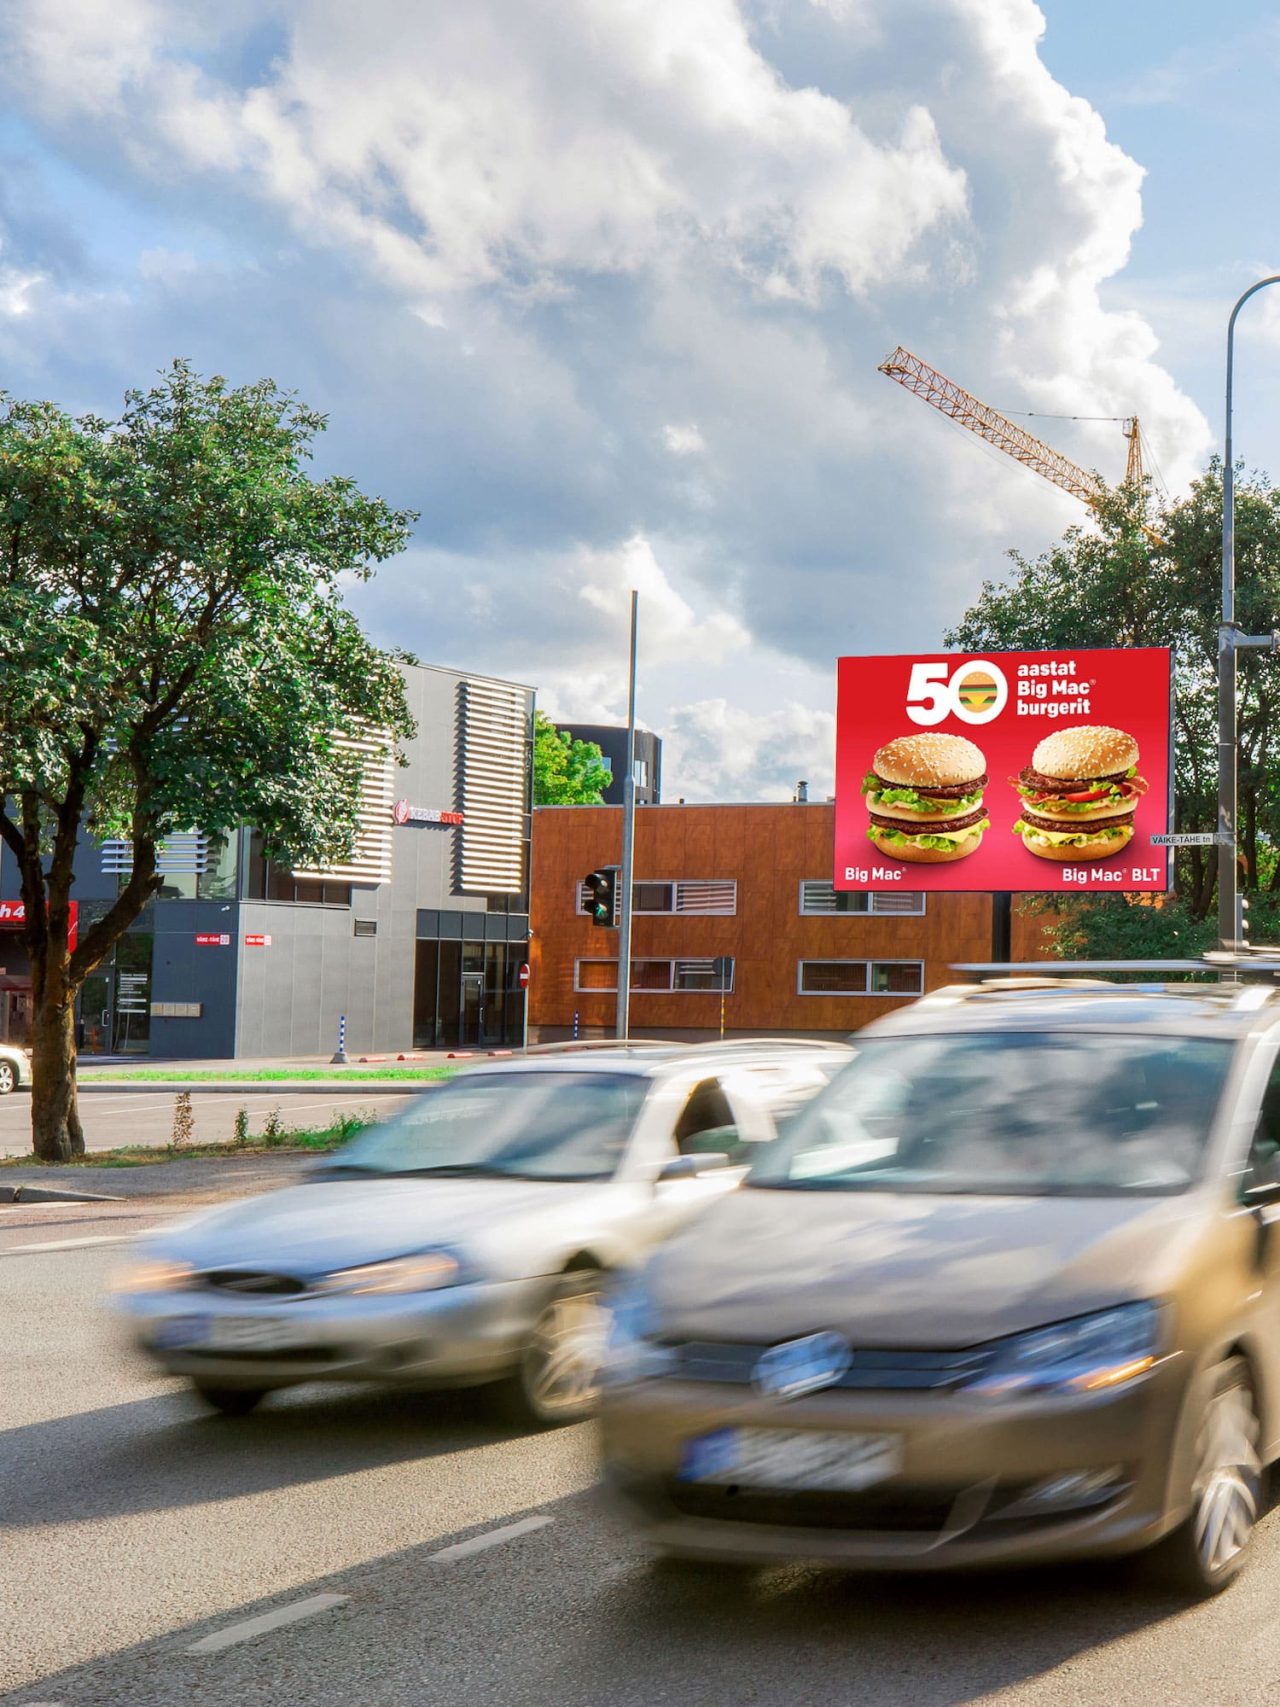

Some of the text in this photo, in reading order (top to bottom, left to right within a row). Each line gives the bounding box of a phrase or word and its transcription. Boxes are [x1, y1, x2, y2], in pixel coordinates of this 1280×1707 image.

[1017, 661, 1076, 677] aastat
[905, 659, 1008, 726] 50
[1017, 680, 1048, 698] Big
[1017, 698, 1091, 718] burgerit
[845, 867, 869, 883] Big
[1062, 868, 1087, 885] Big
[1132, 868, 1160, 882] BLT
